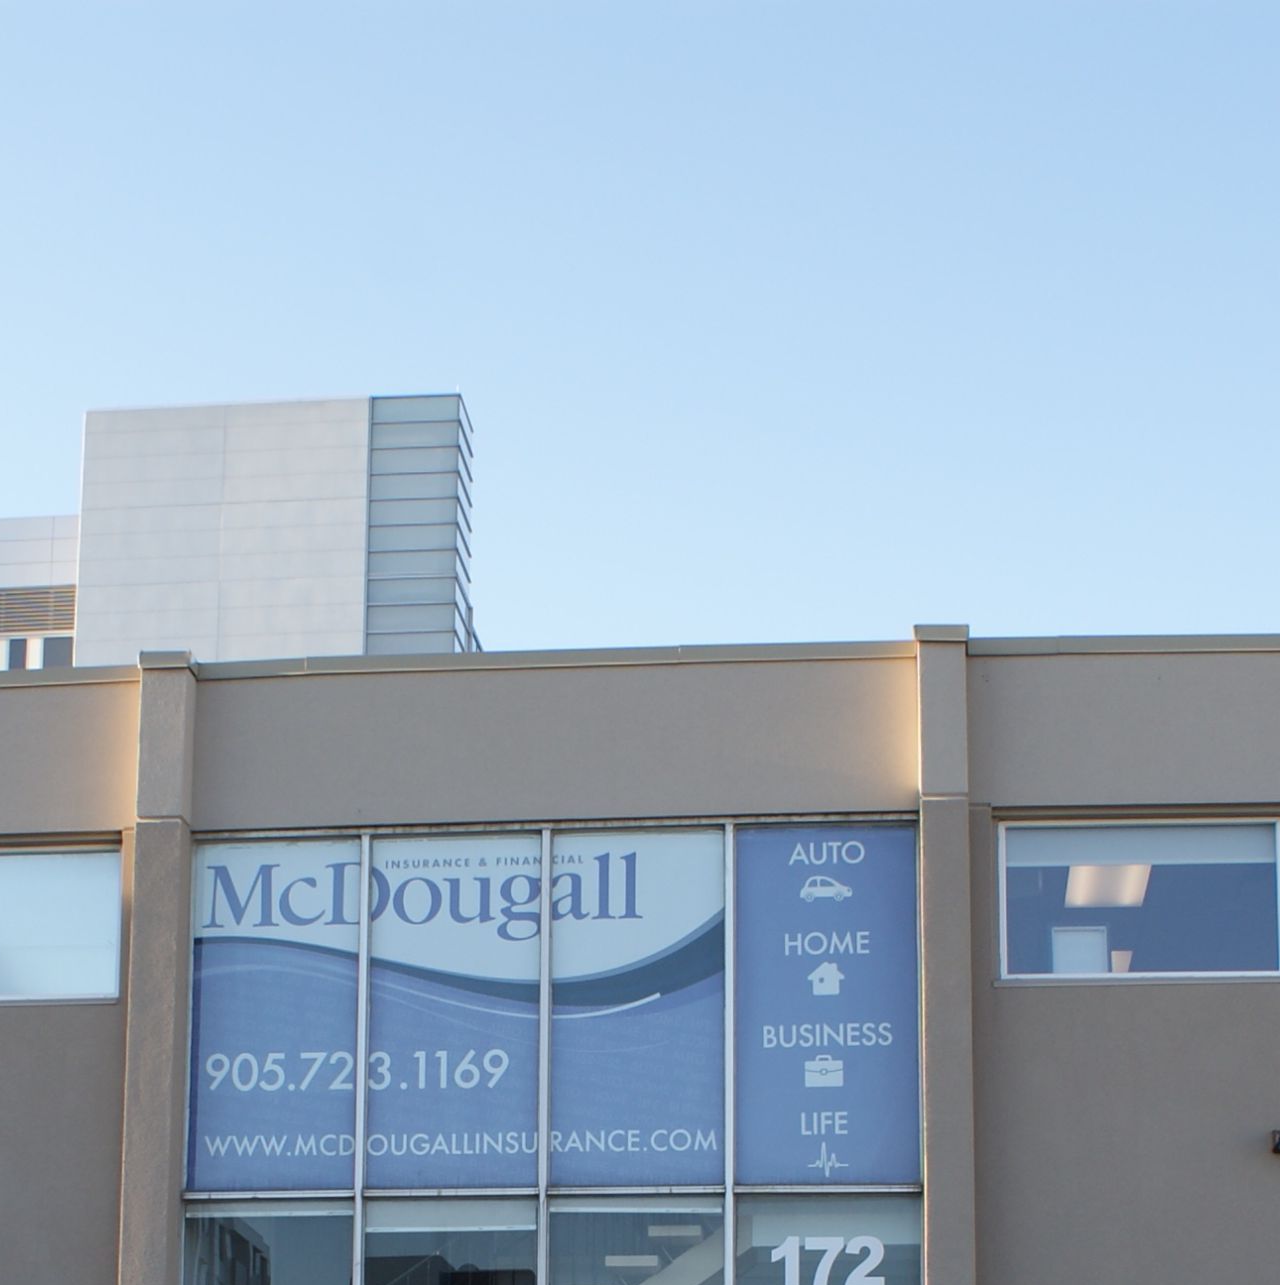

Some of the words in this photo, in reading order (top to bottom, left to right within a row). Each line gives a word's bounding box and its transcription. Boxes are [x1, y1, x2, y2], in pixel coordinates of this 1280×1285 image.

[384, 857, 470, 870] INSURANCE
[477, 856, 488, 867] &
[495, 854, 585, 867] FINANCIAL
[788, 840, 865, 866] AUTO
[201, 851, 644, 942] McDougall
[784, 931, 870, 956] HOME
[762, 1022, 893, 1048] BUSINESS
[204, 1048, 510, 1092] 905.723.1169
[800, 1111, 849, 1136] LIFE
[204, 1129, 718, 1158] WWW.MCDOUGALLINSURANCE.COM
